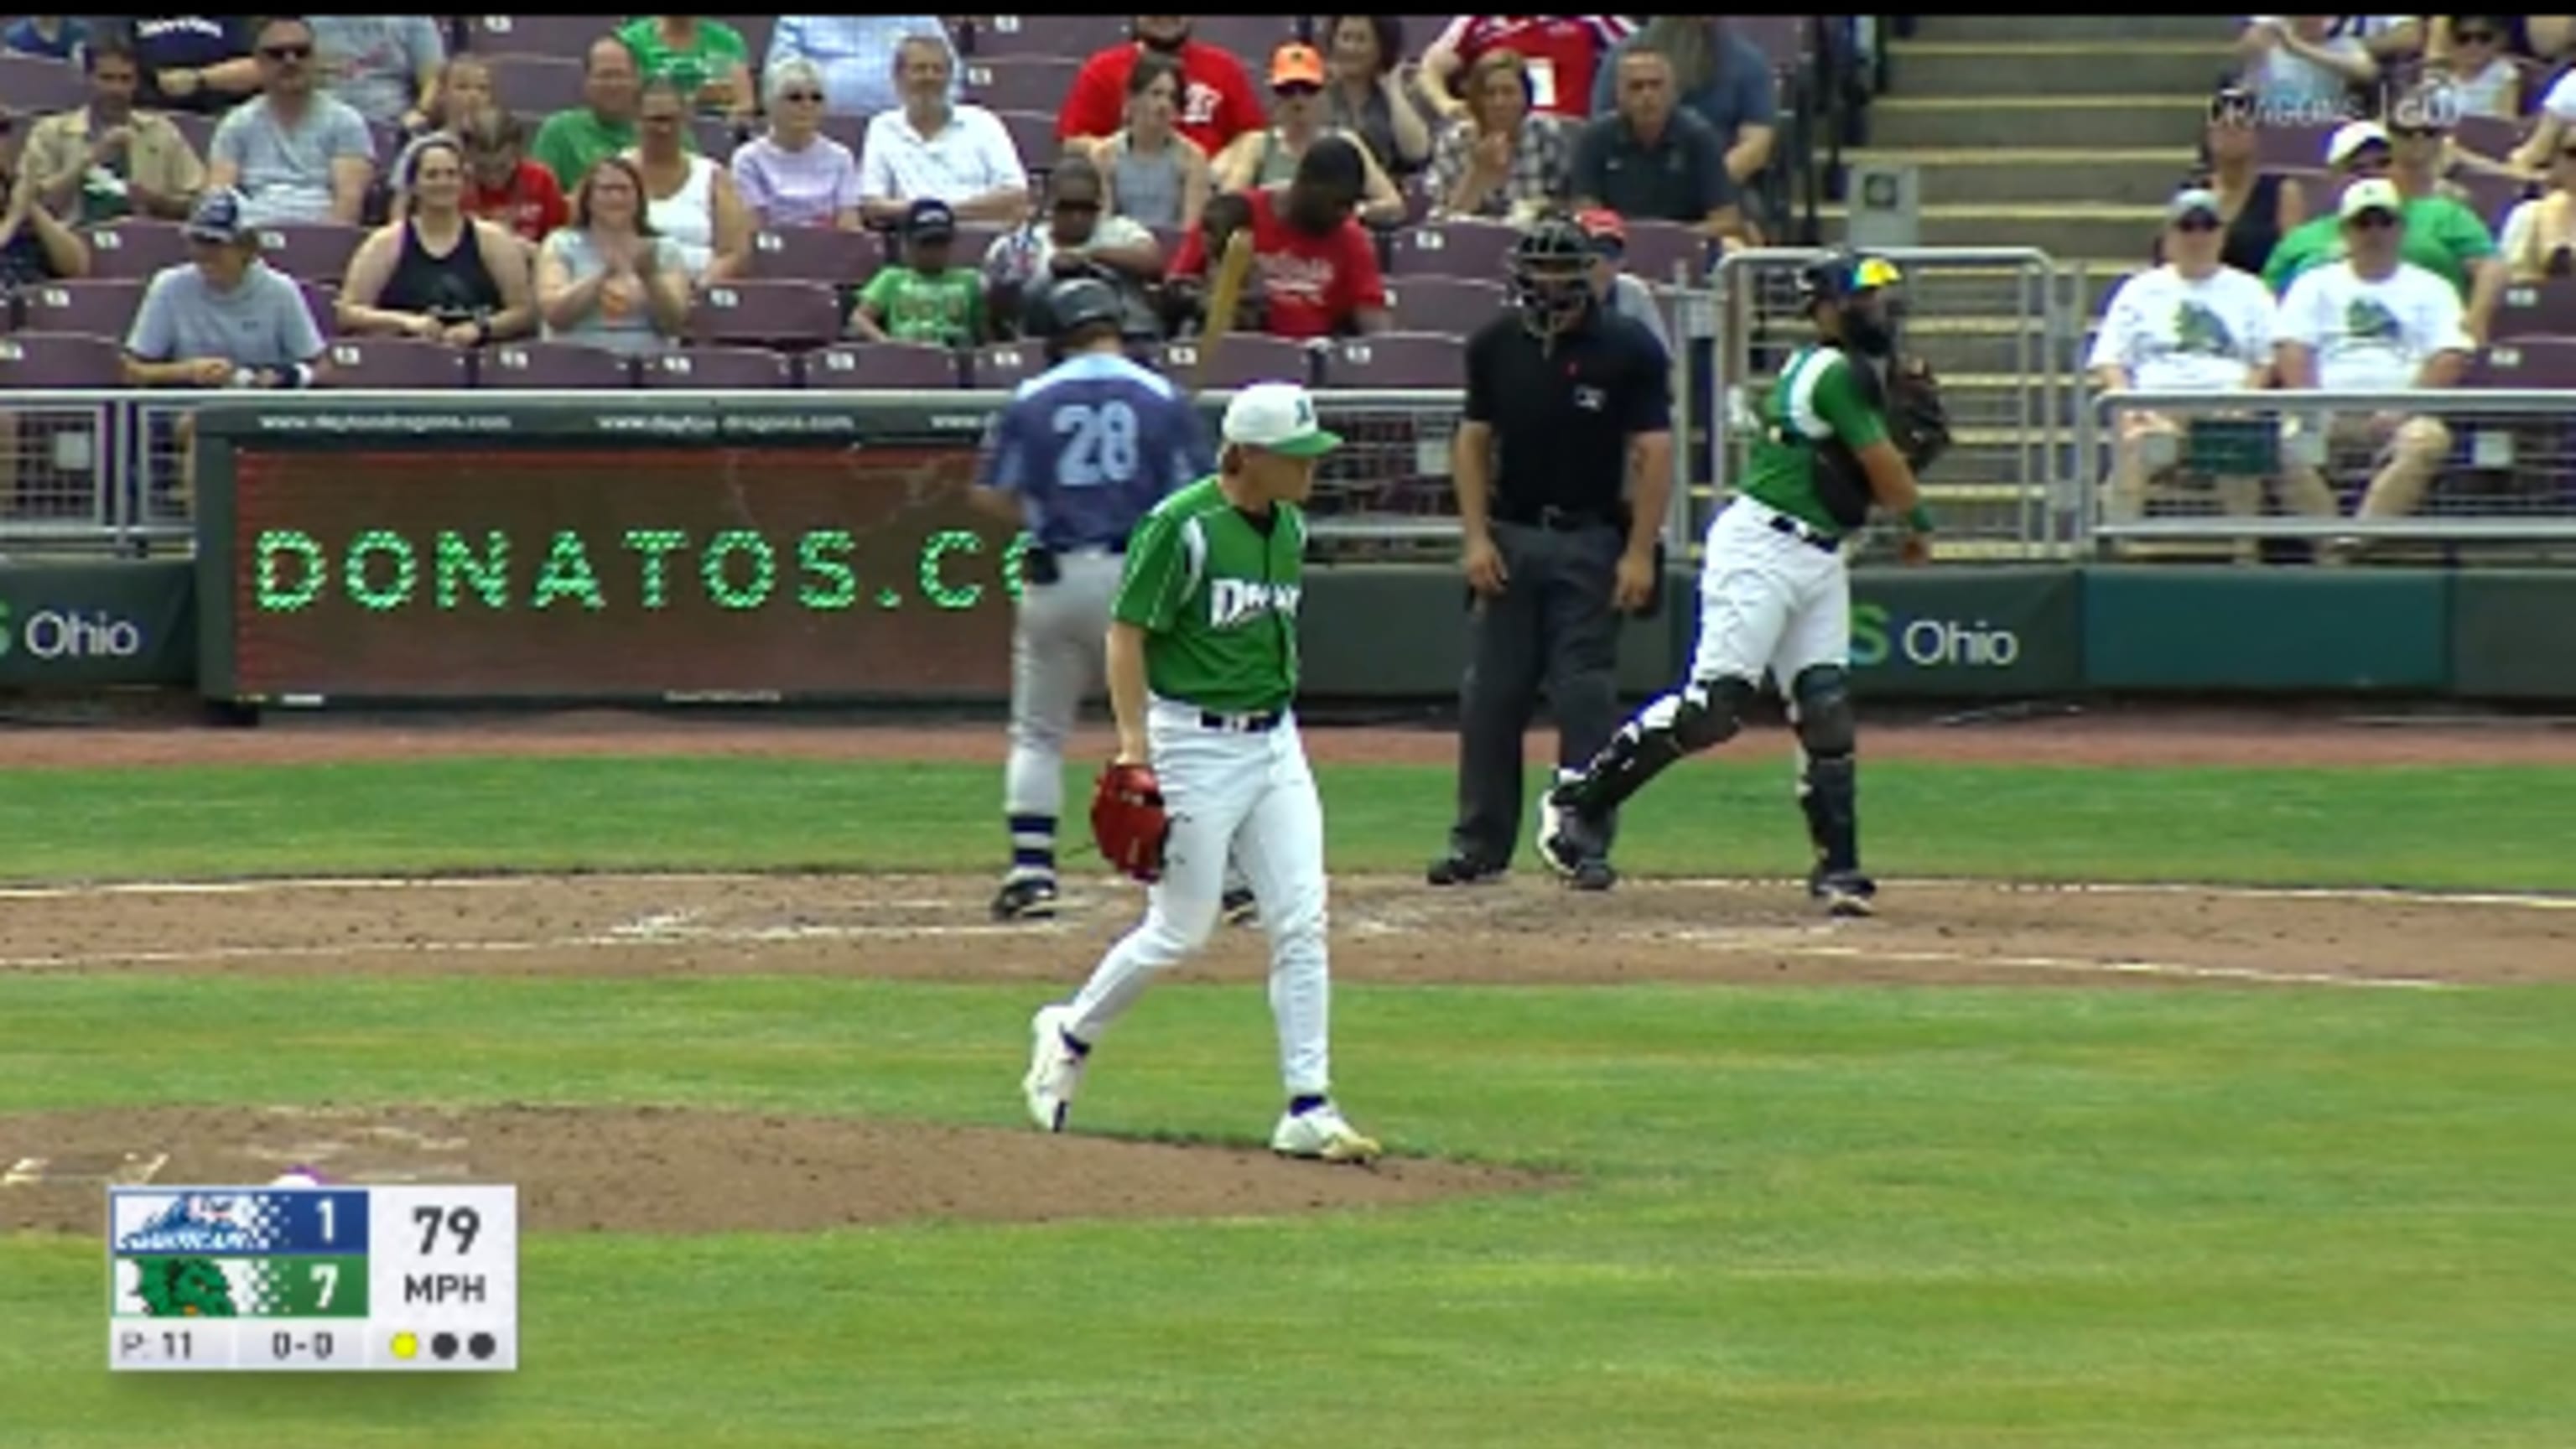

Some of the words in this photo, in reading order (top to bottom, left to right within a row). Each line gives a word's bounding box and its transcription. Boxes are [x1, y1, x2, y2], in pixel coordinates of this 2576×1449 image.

[1054, 401, 1138, 485] 28
[26, 610, 139, 658] Ohio
[1903, 620, 2018, 665] Ohio
